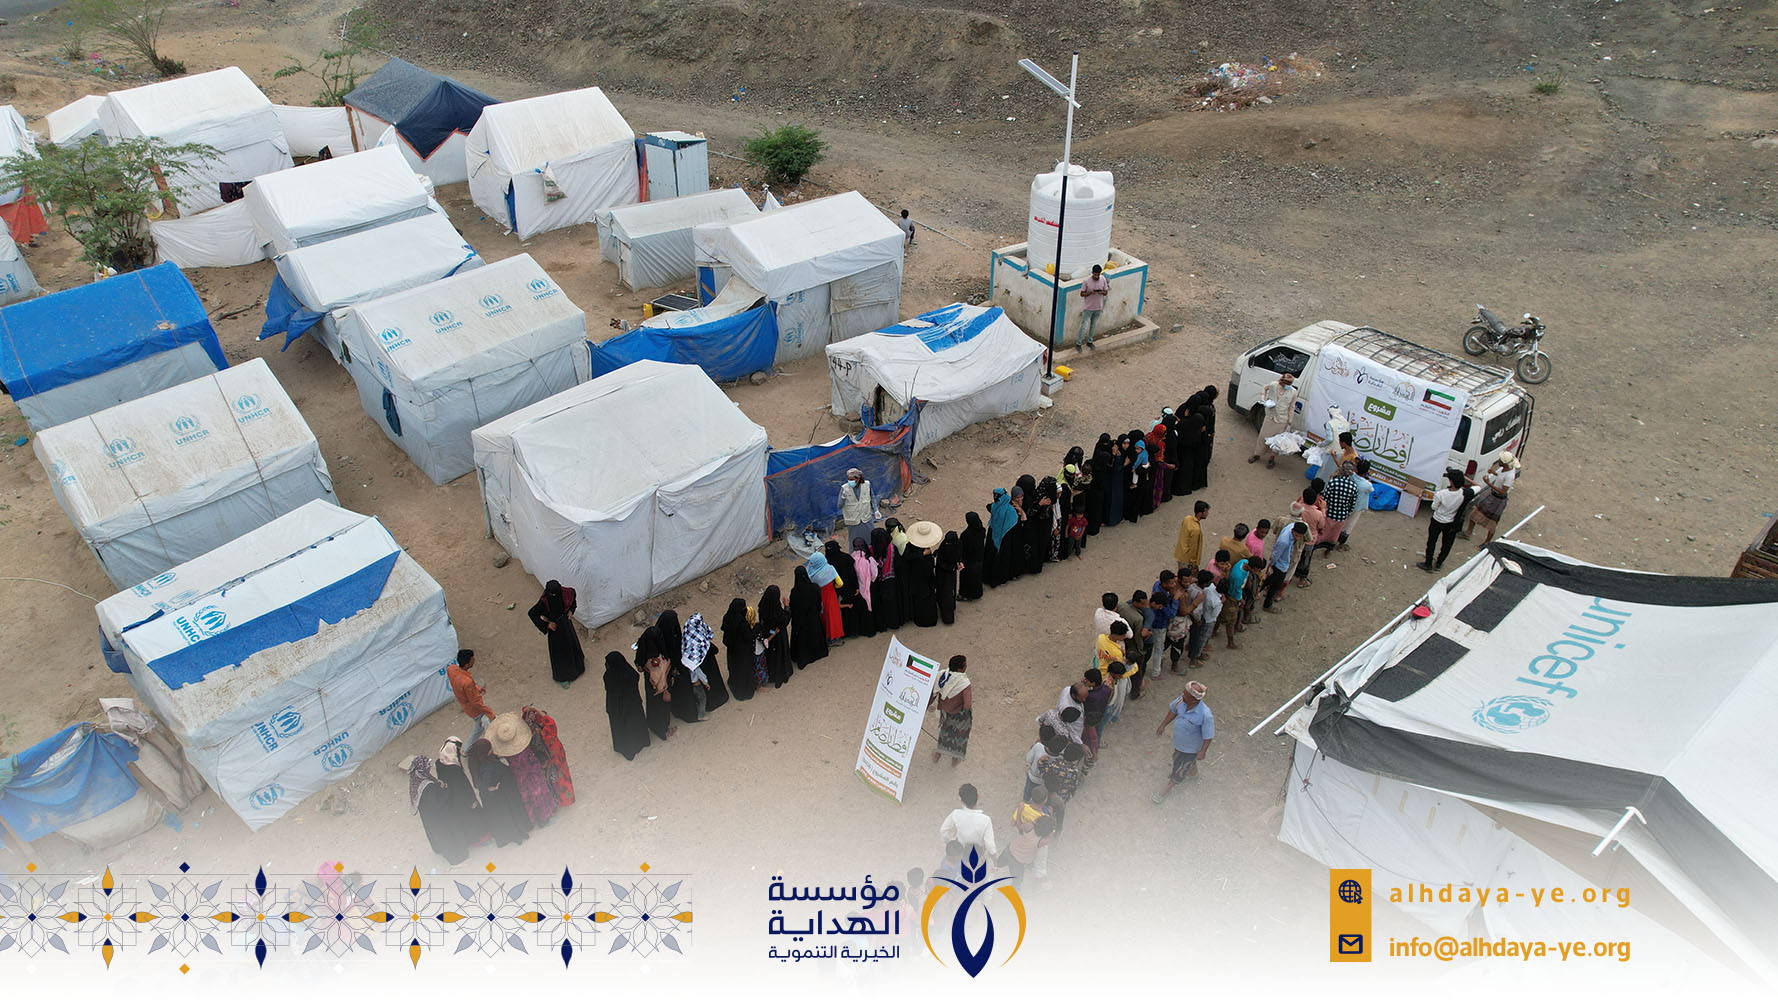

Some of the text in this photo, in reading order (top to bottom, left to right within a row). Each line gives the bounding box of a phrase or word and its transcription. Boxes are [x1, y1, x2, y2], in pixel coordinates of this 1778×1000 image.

[532, 289, 559, 301] UNHCR
[485, 305, 512, 317] UNHCR
[435, 321, 463, 334] UNHCR
[237, 408, 271, 424] UNHCR
[1367, 403, 1392, 416] مشروع
[175, 429, 209, 445] UNHCR
[108, 451, 145, 468] UNHCR
[176, 616, 201, 643] UNHC
[313, 731, 350, 756] UNHCR
